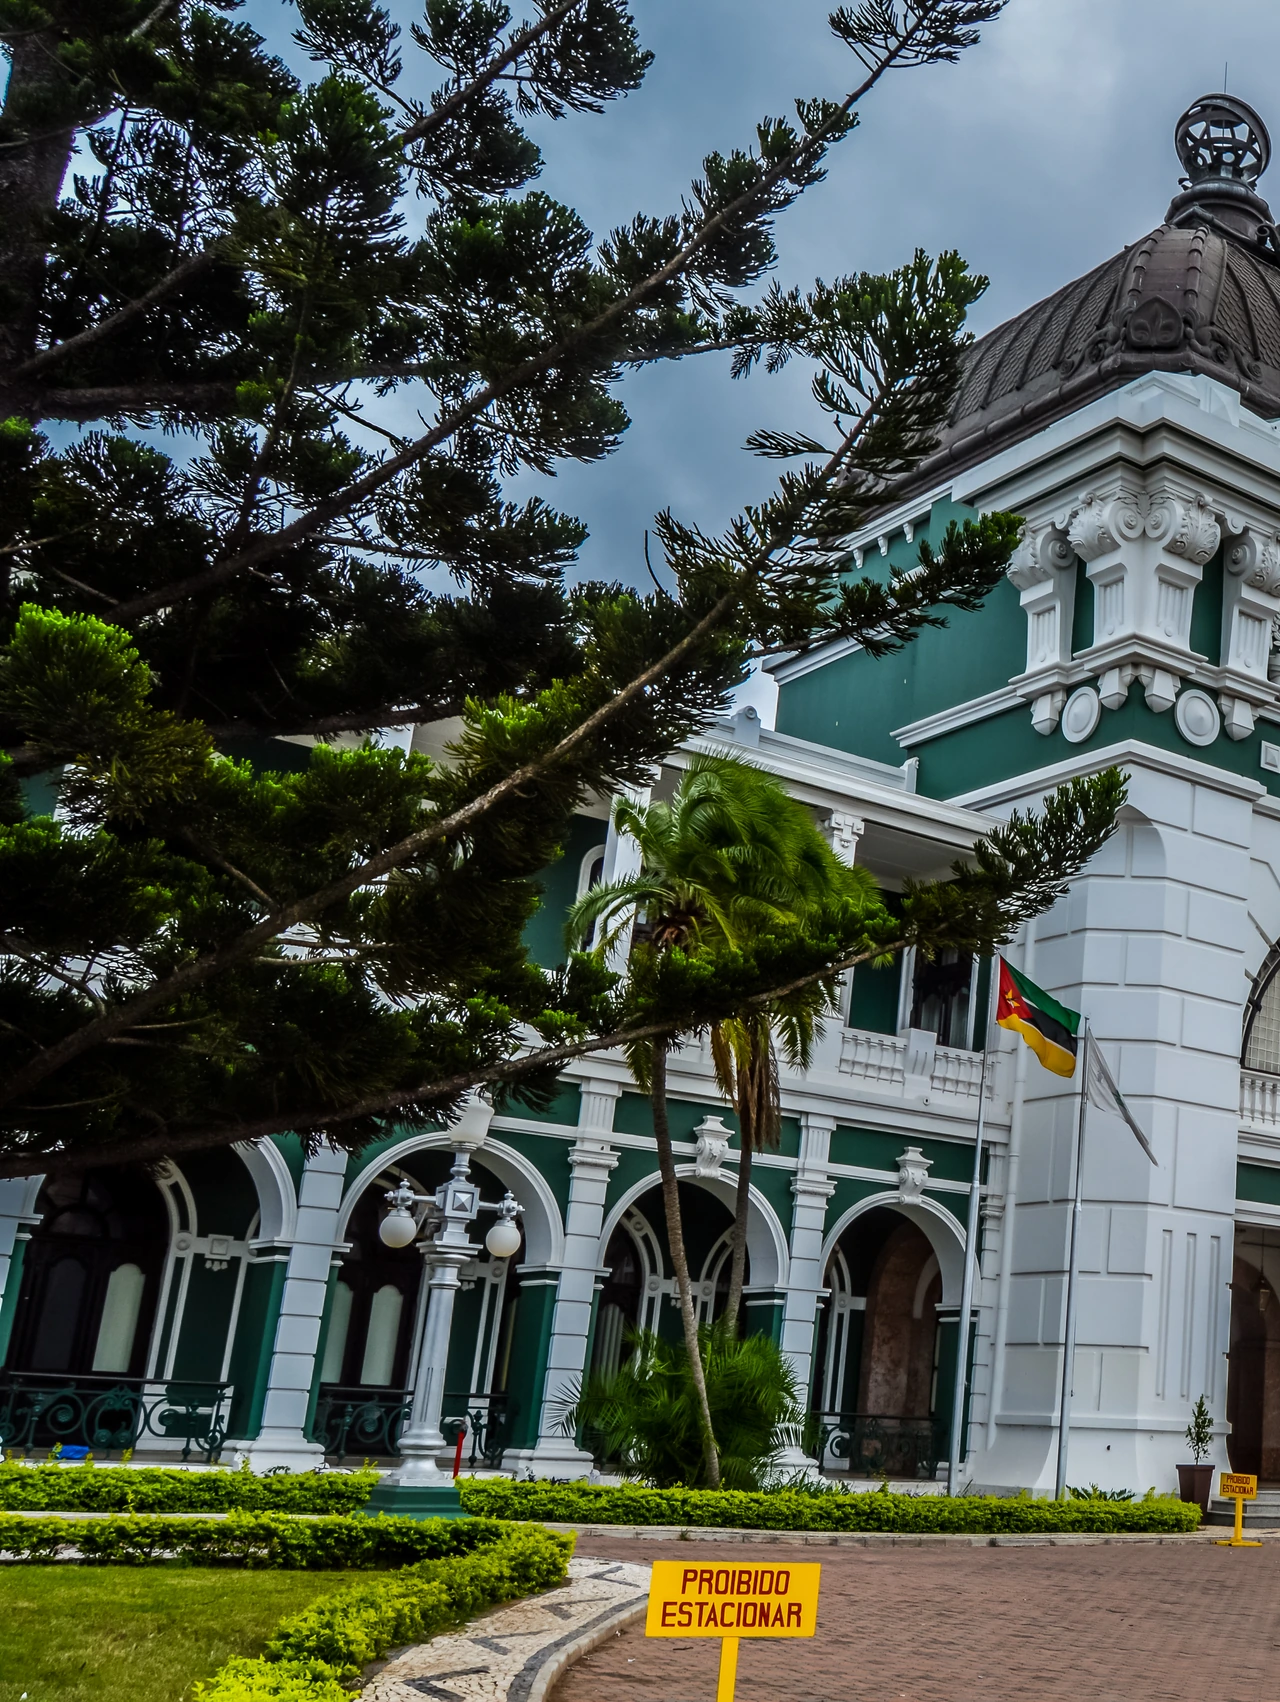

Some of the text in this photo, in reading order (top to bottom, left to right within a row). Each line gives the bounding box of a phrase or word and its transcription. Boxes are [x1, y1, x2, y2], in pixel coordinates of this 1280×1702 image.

[1226, 1475, 1250, 1485] PROIBIDO
[1222, 1484, 1254, 1495] ESTACIONAR
[681, 1569, 790, 1595] PROIBIDO
[661, 1601, 802, 1628] ESTACIONAR
